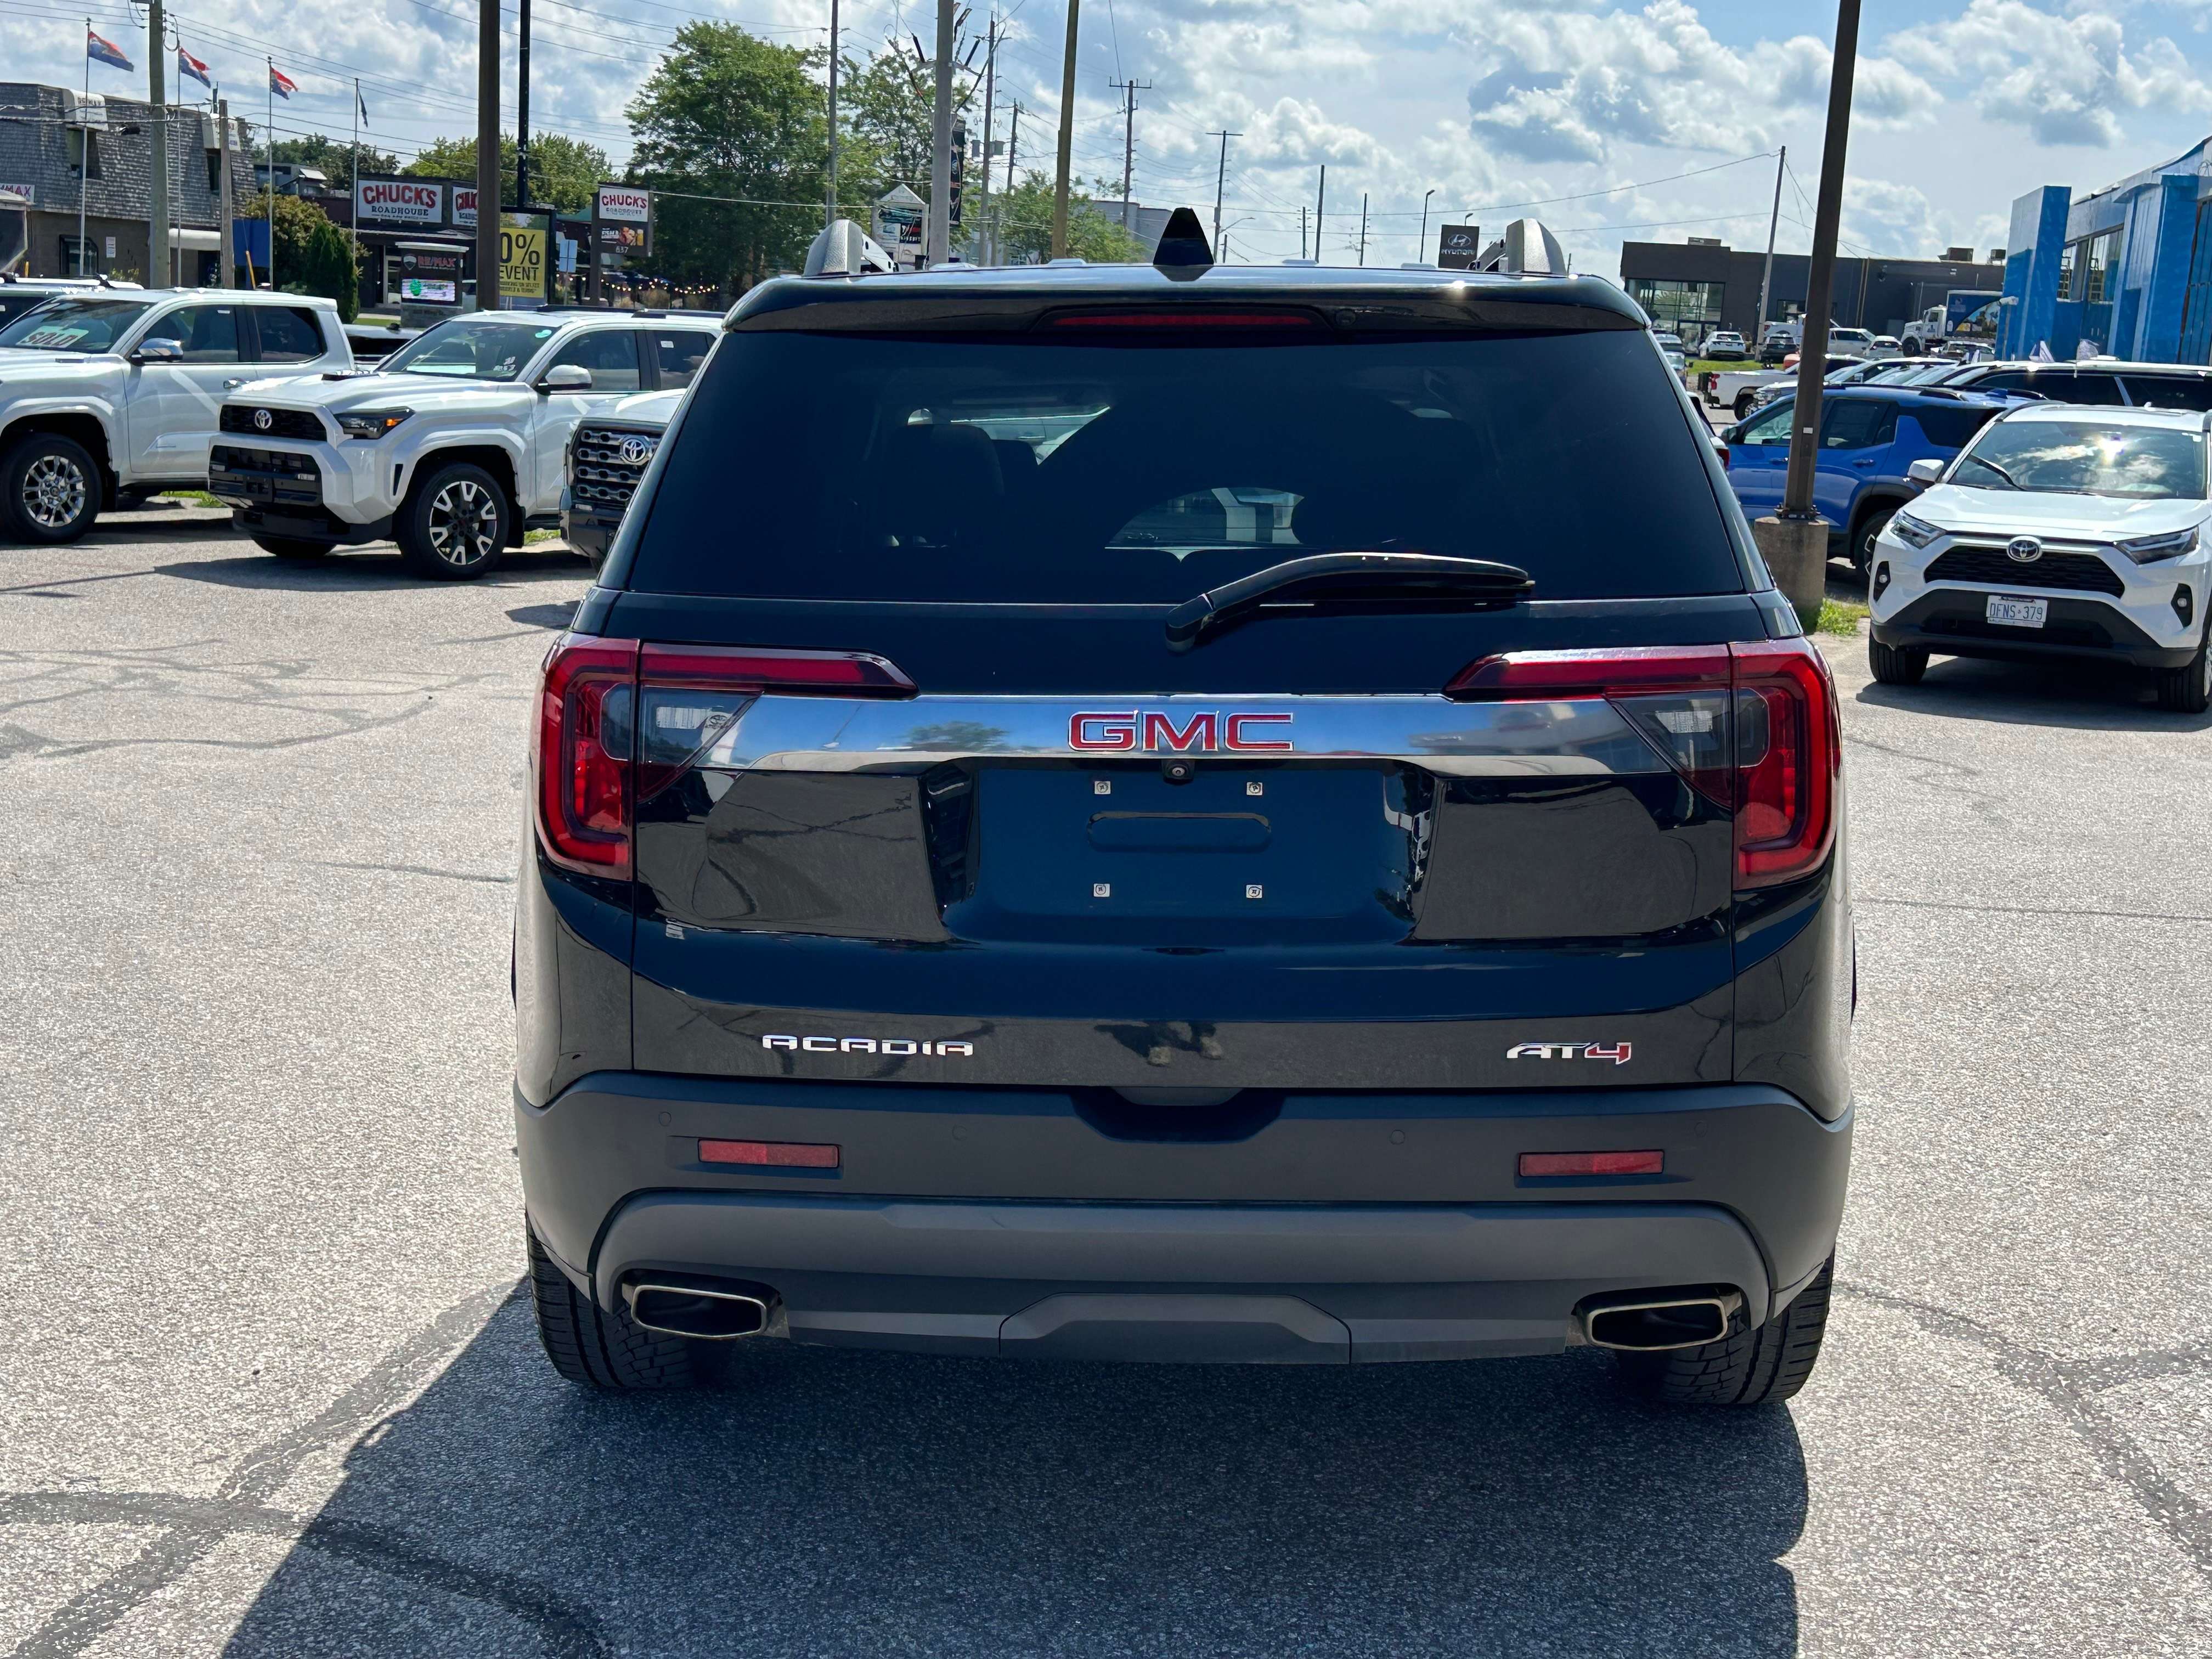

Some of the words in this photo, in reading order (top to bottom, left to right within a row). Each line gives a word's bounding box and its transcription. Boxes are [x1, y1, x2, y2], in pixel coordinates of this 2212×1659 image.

[362, 184, 437, 208] CHUCK'S
[602, 194, 647, 209] CHUCK'S
[371, 205, 428, 216] ROADHOUSE
[2023, 606, 2043, 620] 379
[1068, 710, 1294, 752] GMC
[762, 1034, 973, 1056] ACADIA
[1506, 1042, 1632, 1065] AT4
